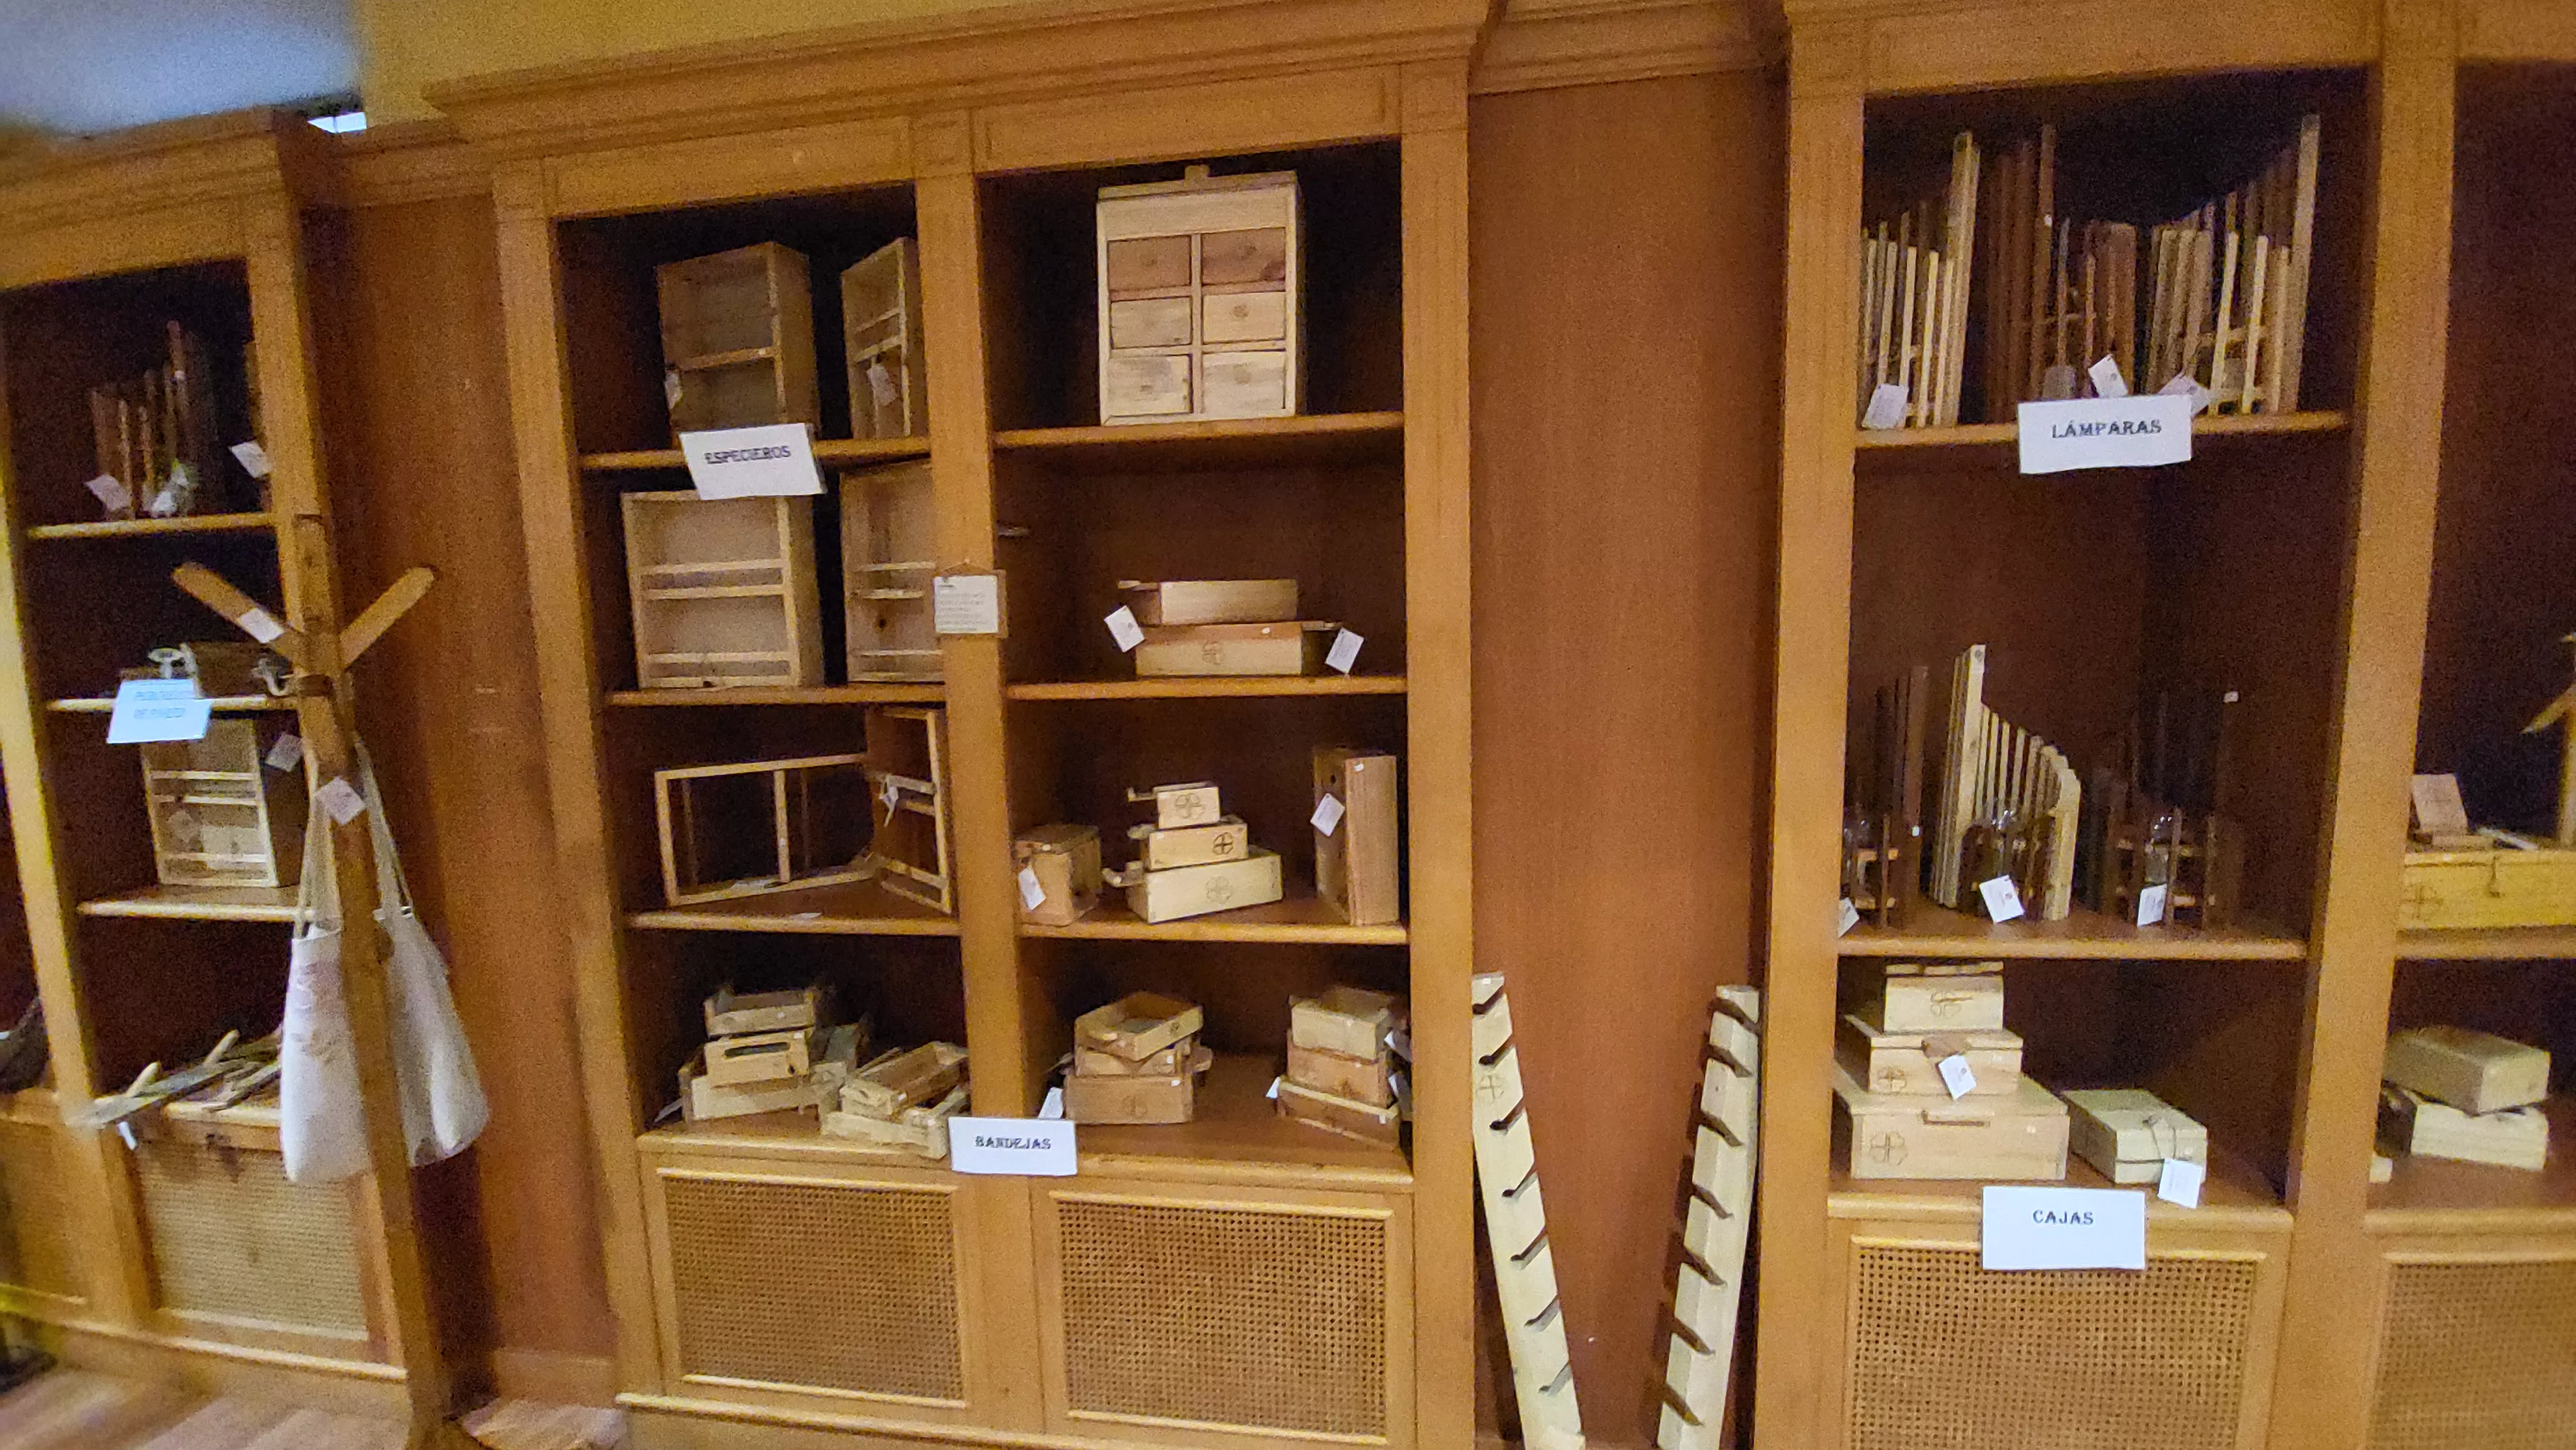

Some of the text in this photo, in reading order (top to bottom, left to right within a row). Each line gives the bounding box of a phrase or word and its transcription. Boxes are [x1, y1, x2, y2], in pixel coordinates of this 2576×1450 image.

[2052, 419, 2162, 438] LÁMPARAS
[704, 445, 792, 464] ESPECIEROS
[975, 1135, 1052, 1150] BANDEJAS
[2032, 1209, 2094, 1225] CAJAS
